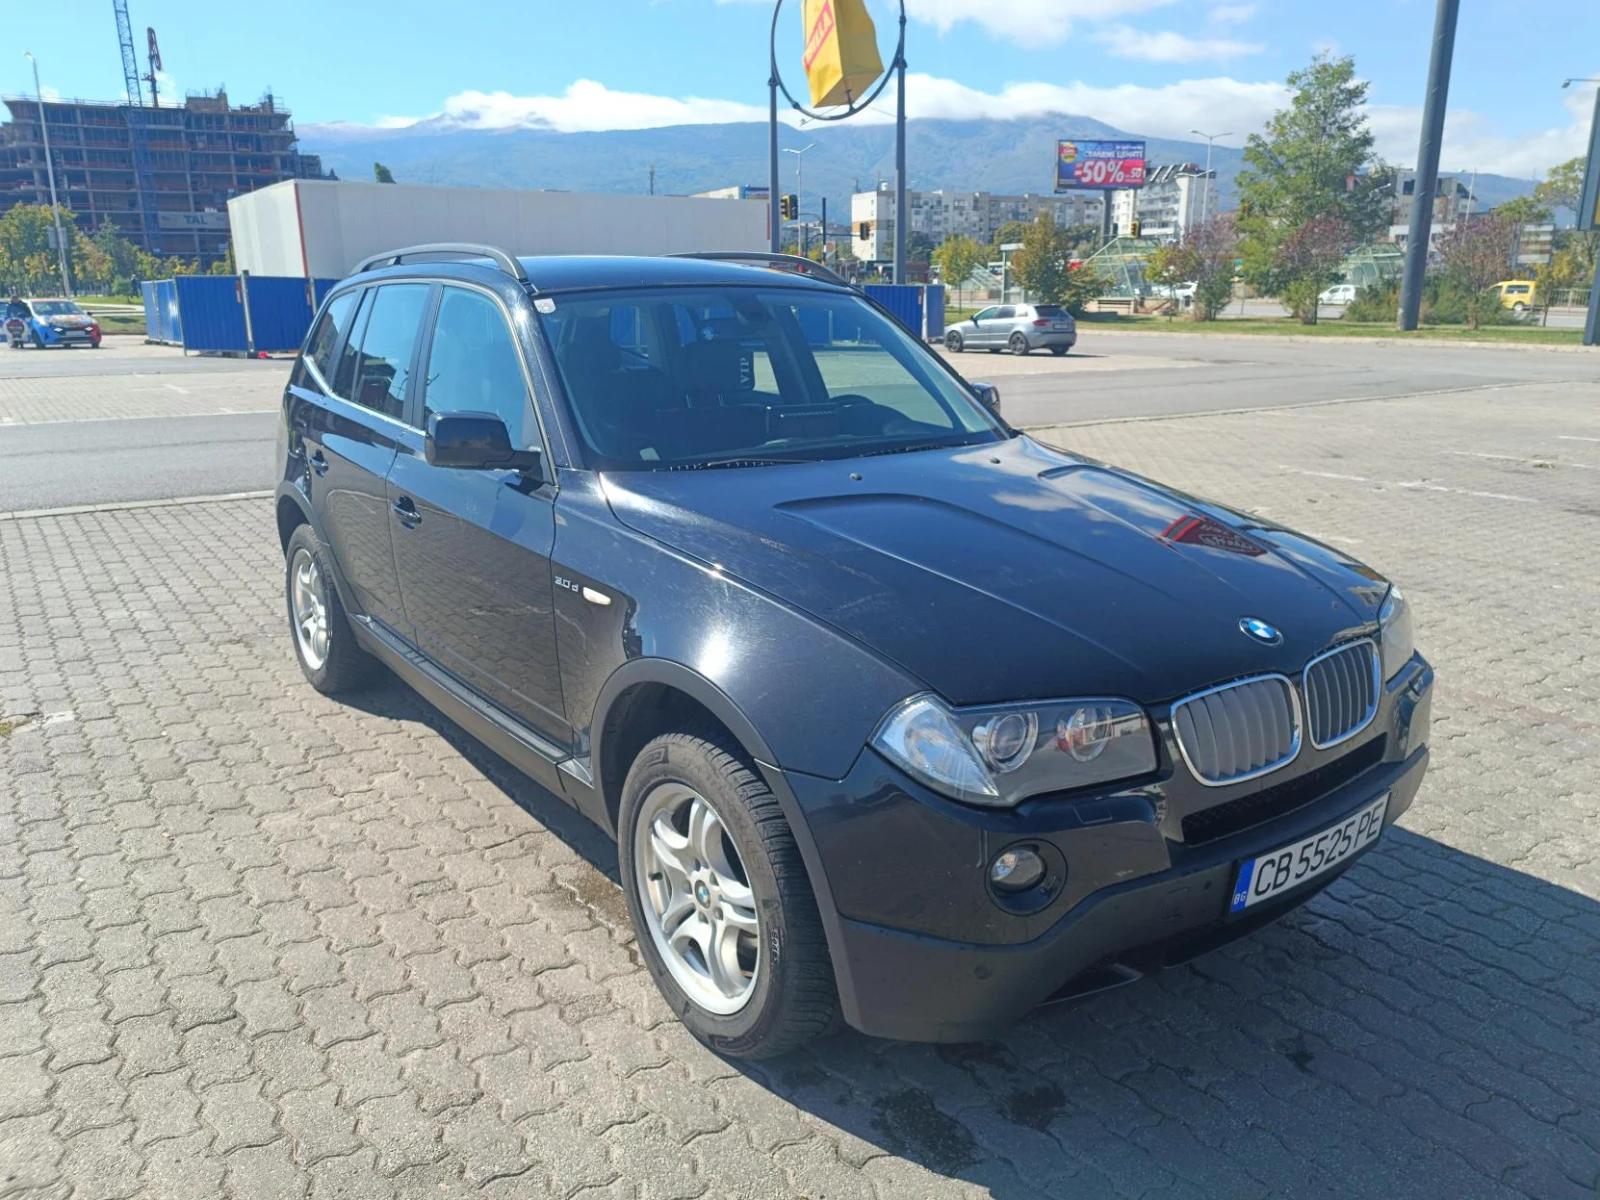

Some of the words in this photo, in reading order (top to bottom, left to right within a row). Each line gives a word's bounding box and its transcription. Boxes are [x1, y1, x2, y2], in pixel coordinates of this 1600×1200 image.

[1255, 852, 1293, 896] CB
[1295, 821, 1355, 879] 5525
[1353, 802, 1383, 848] PE
[1234, 891, 1247, 905] BG
